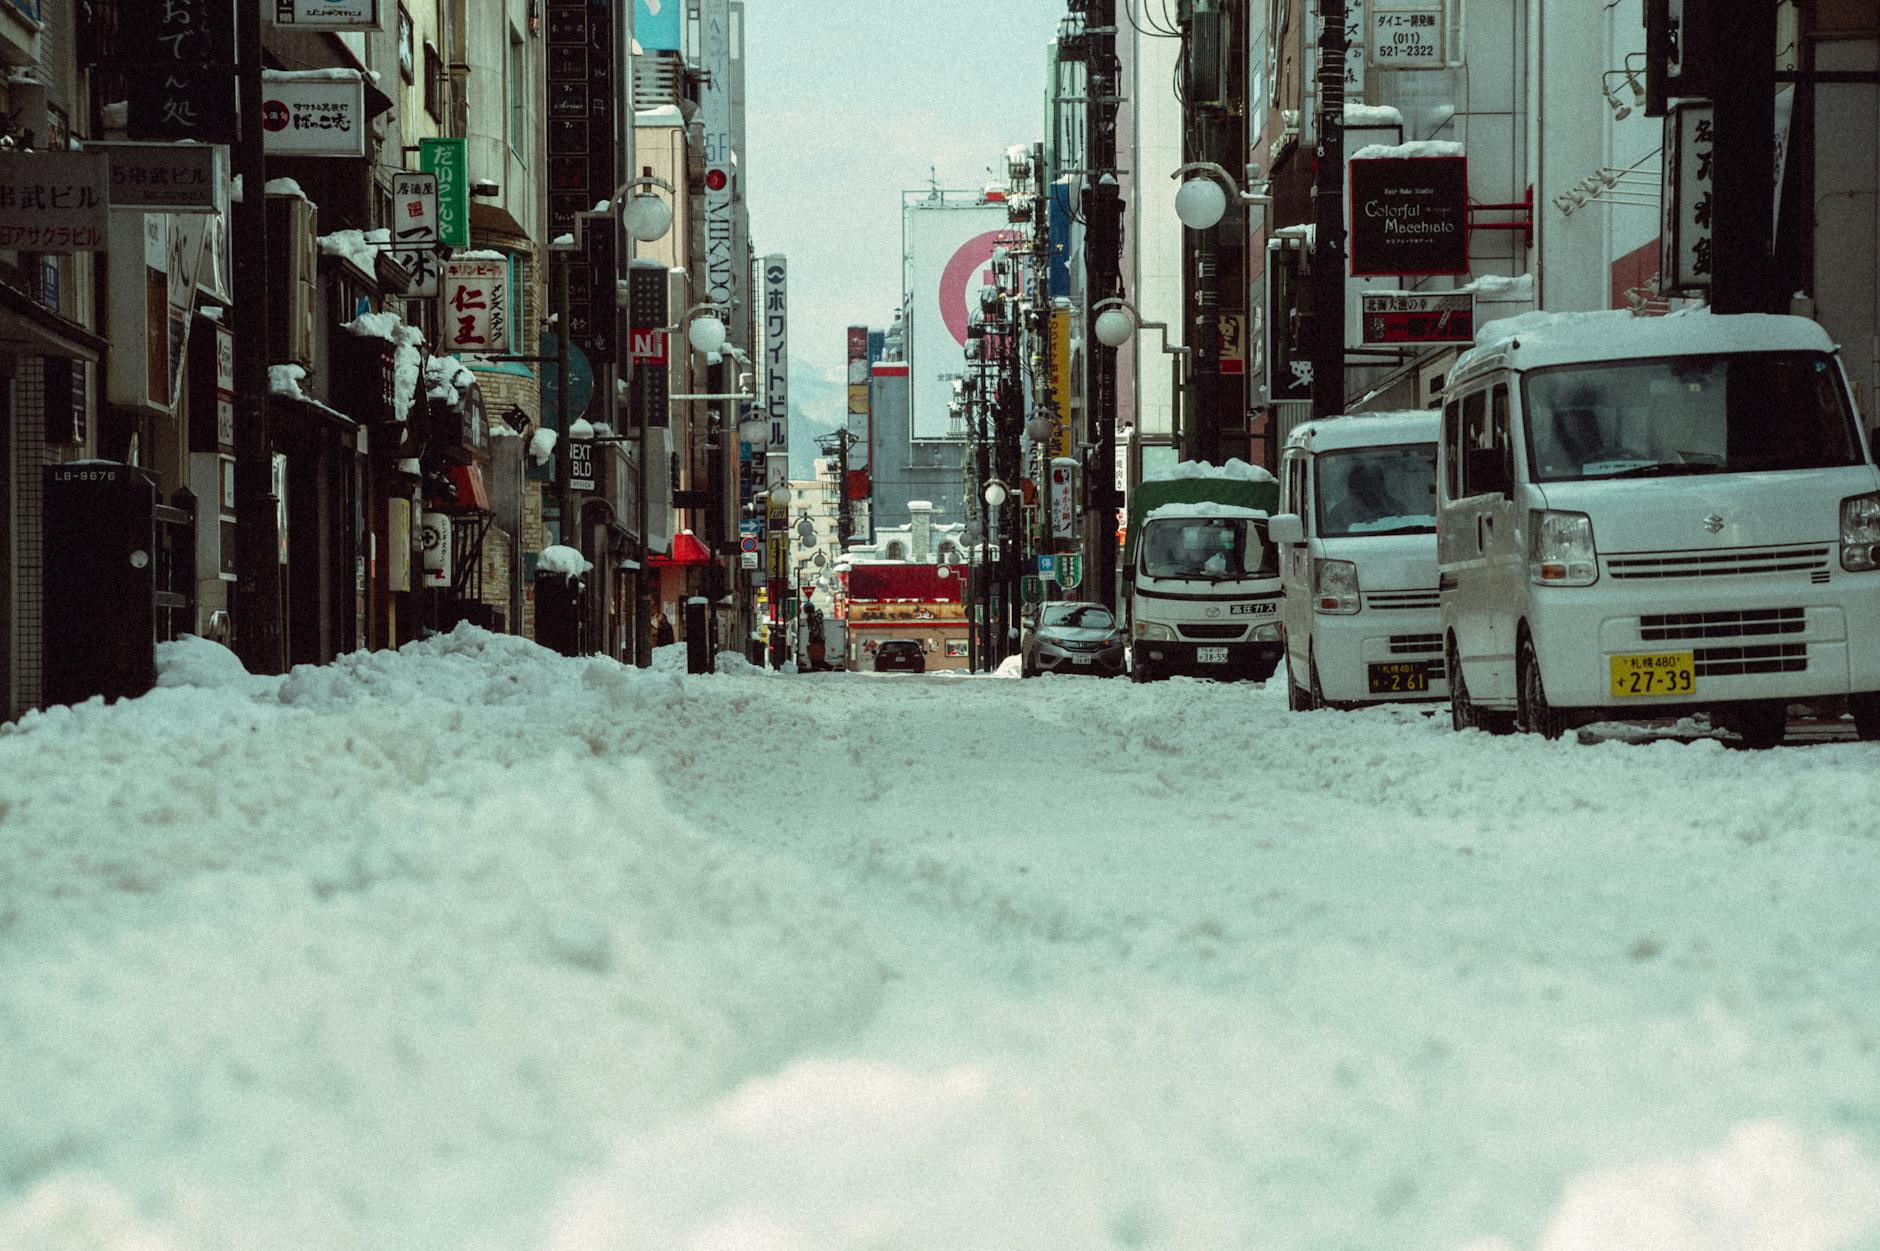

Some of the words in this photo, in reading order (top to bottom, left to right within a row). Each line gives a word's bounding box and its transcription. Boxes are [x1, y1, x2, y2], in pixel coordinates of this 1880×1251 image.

[1393, 32, 1421, 44] (011)
[1379, 46, 1434, 57] 521-2322
[706, 133, 728, 162] 5F
[396, 182, 434, 195] 居酒屋
[1365, 199, 1420, 220] Colorful
[1384, 218, 1455, 234] Macchiato
[709, 200, 730, 305] MIKADO
[448, 263, 502, 276] キリンビール
[449, 285, 488, 346] 仁王
[767, 288, 786, 446] ホワイトビル
[573, 461, 592, 477] BLD
[1232, 604, 1275, 614] 高圧ガス
[1630, 670, 1691, 692] 27-39
